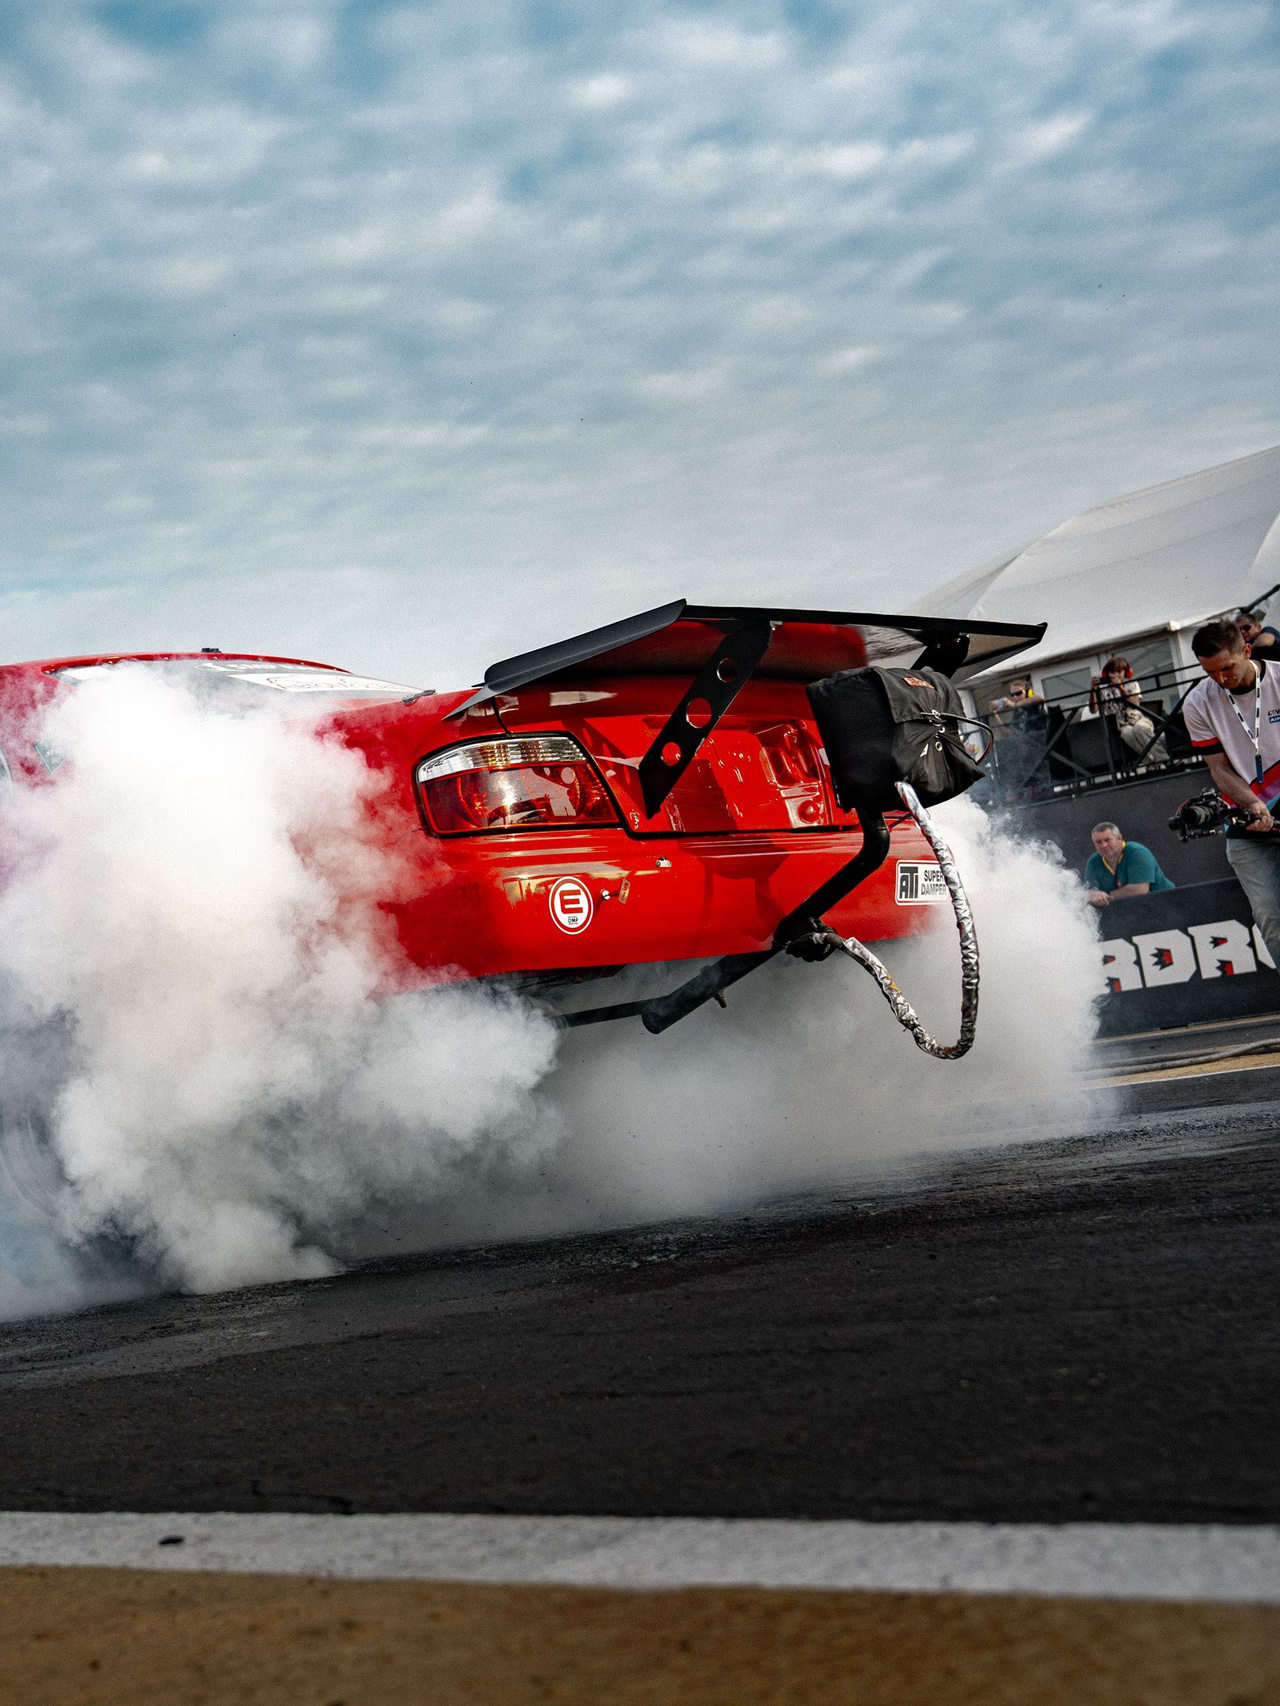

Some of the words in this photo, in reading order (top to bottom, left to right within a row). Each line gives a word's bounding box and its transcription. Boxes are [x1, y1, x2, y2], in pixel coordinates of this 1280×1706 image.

[924, 869, 945, 882] SUPER
[899, 866, 918, 899] ATI
[921, 883, 947, 896] DAMPER
